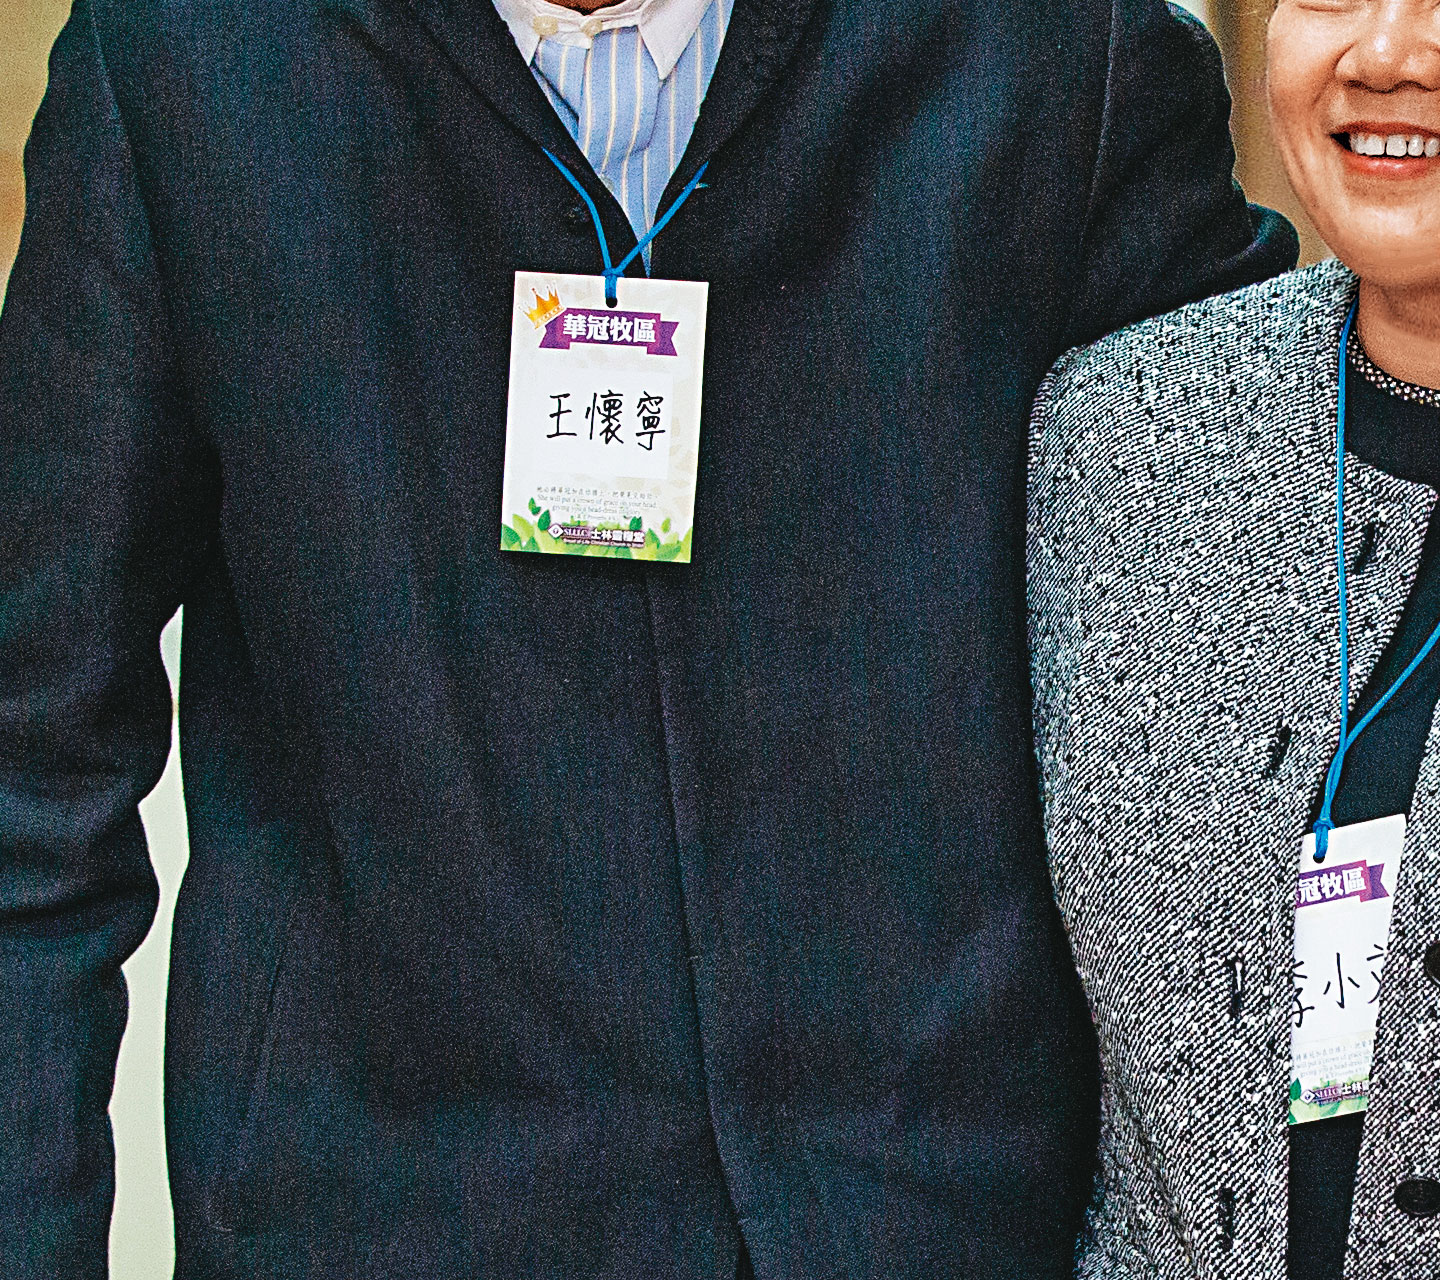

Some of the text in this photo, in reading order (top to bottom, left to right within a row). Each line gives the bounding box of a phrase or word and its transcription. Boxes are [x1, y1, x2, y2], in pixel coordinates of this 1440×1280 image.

[562, 313, 657, 344] 華冠牧區
[1295, 866, 1366, 905] 冠牧區
